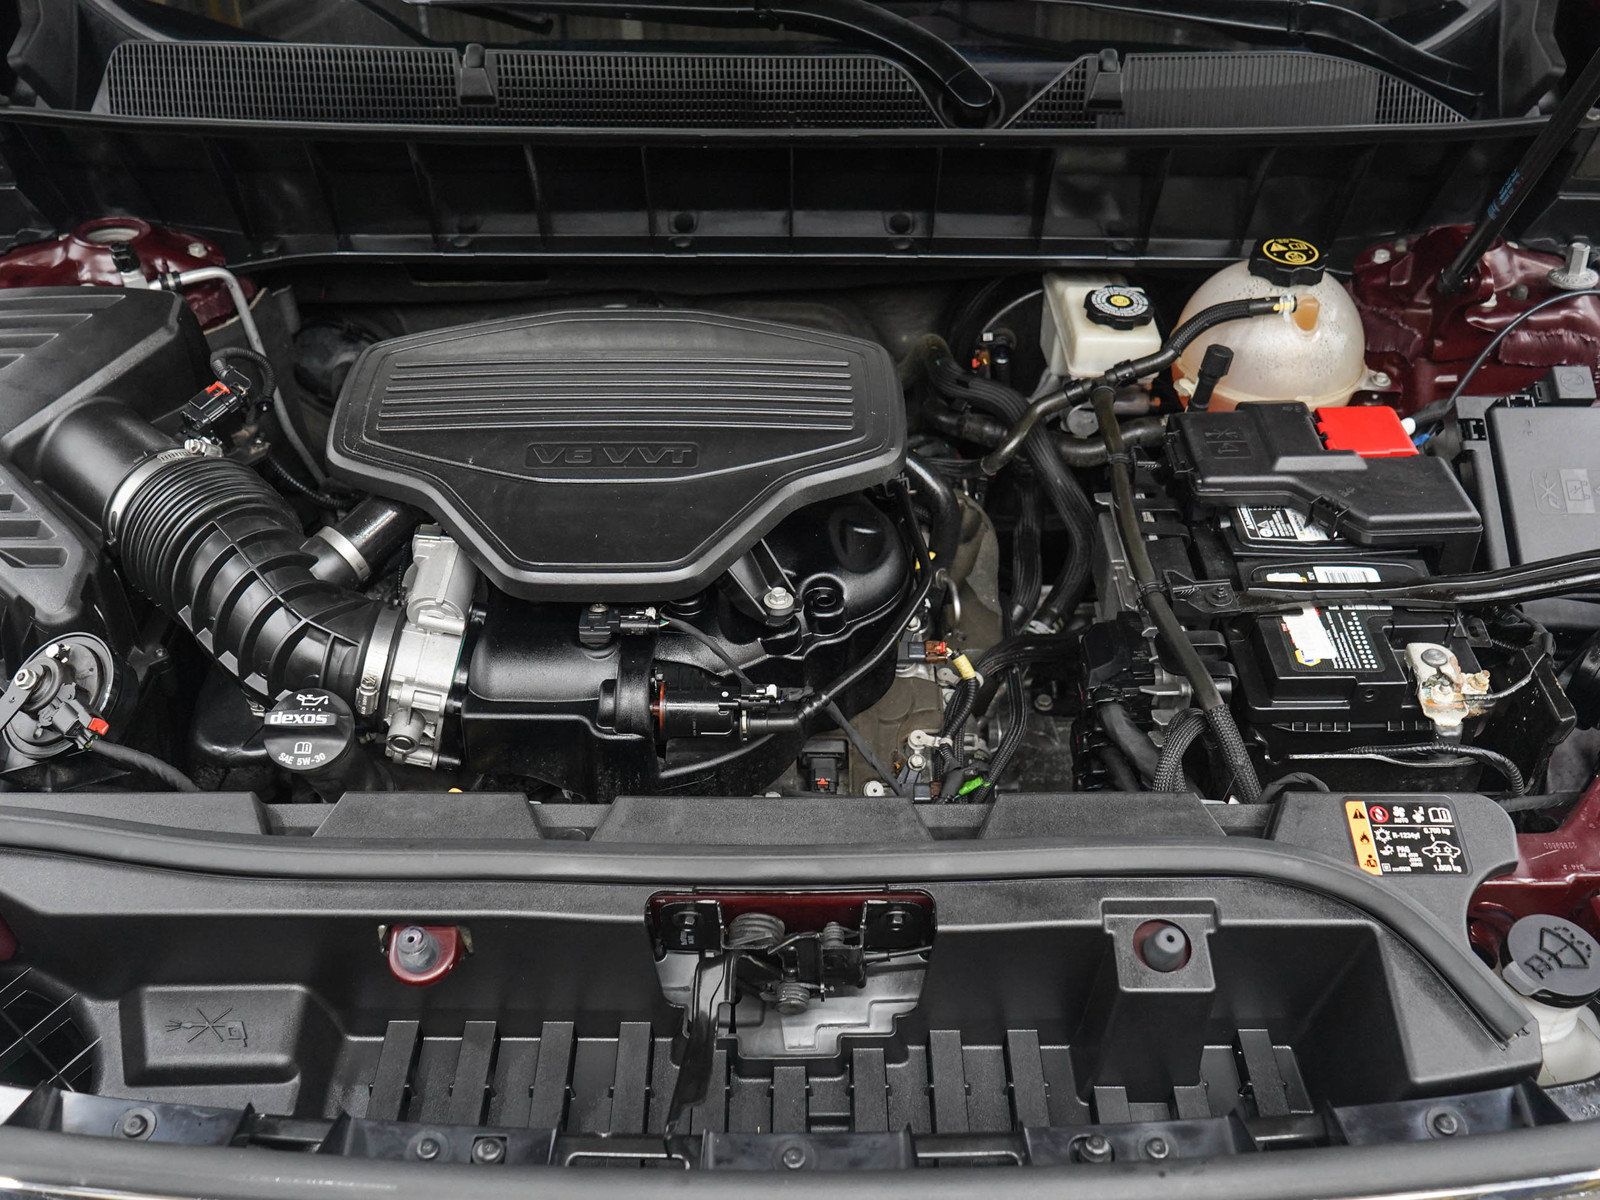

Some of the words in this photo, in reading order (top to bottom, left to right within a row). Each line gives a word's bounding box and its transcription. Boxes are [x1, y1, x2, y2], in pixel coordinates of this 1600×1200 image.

[533, 446, 593, 464] V6
[602, 446, 692, 464] VVT
[269, 711, 328, 725] dexos
[278, 752, 294, 765] SAE
[296, 752, 326, 766] 5W-30
